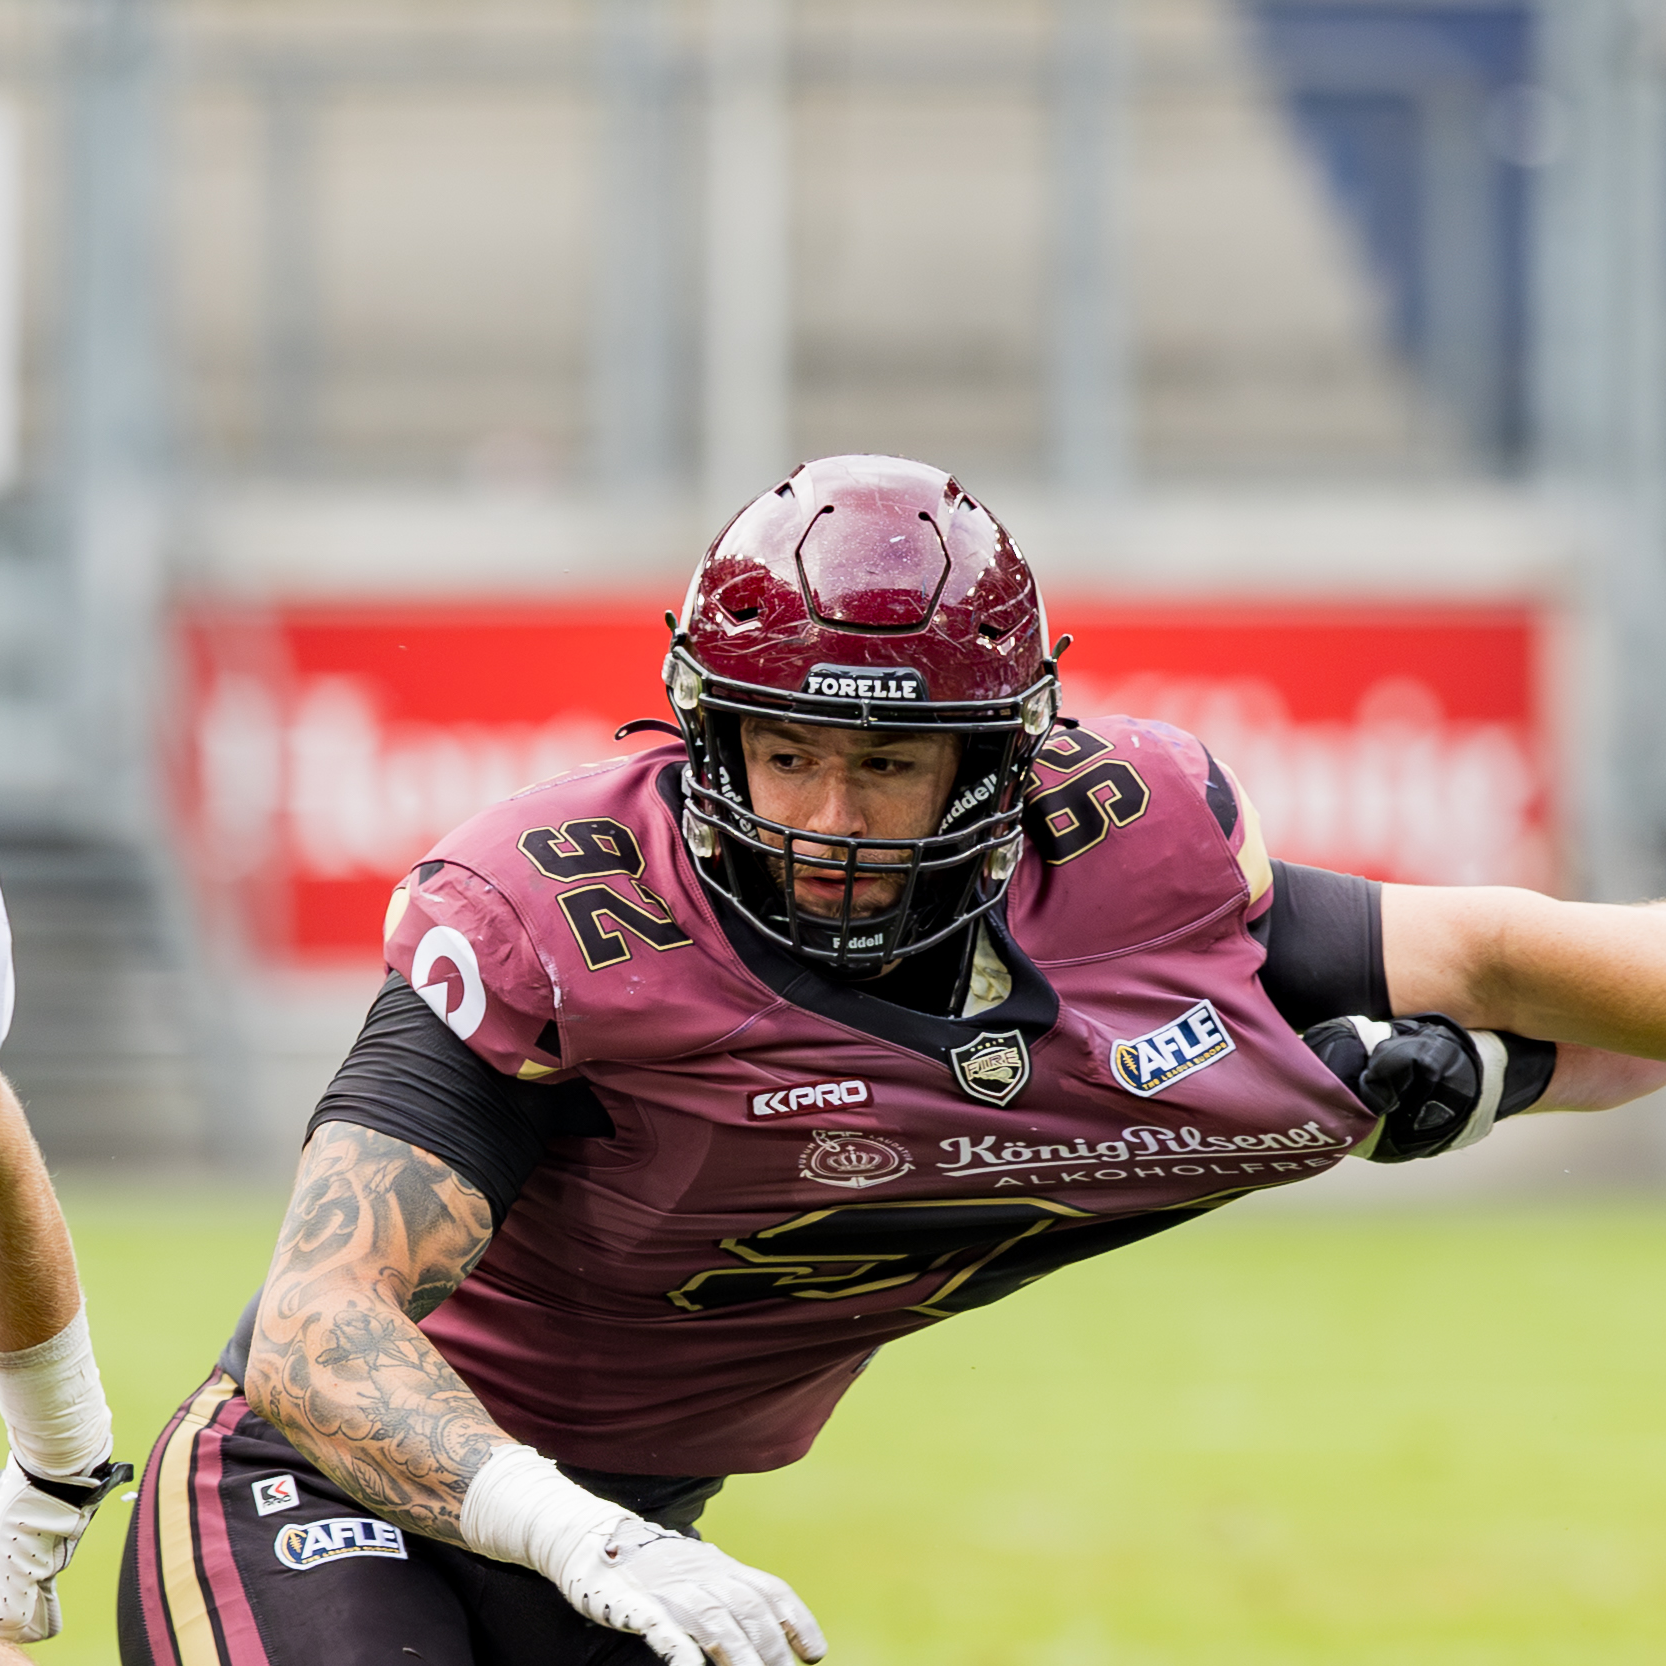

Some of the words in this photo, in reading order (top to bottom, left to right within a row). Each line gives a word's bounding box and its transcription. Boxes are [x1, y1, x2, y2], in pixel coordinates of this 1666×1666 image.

[807, 676, 917, 699] FORELLE
[517, 816, 694, 972] 92
[1136, 1008, 1223, 1083] AFLE
[300, 1521, 399, 1559] AFLE
